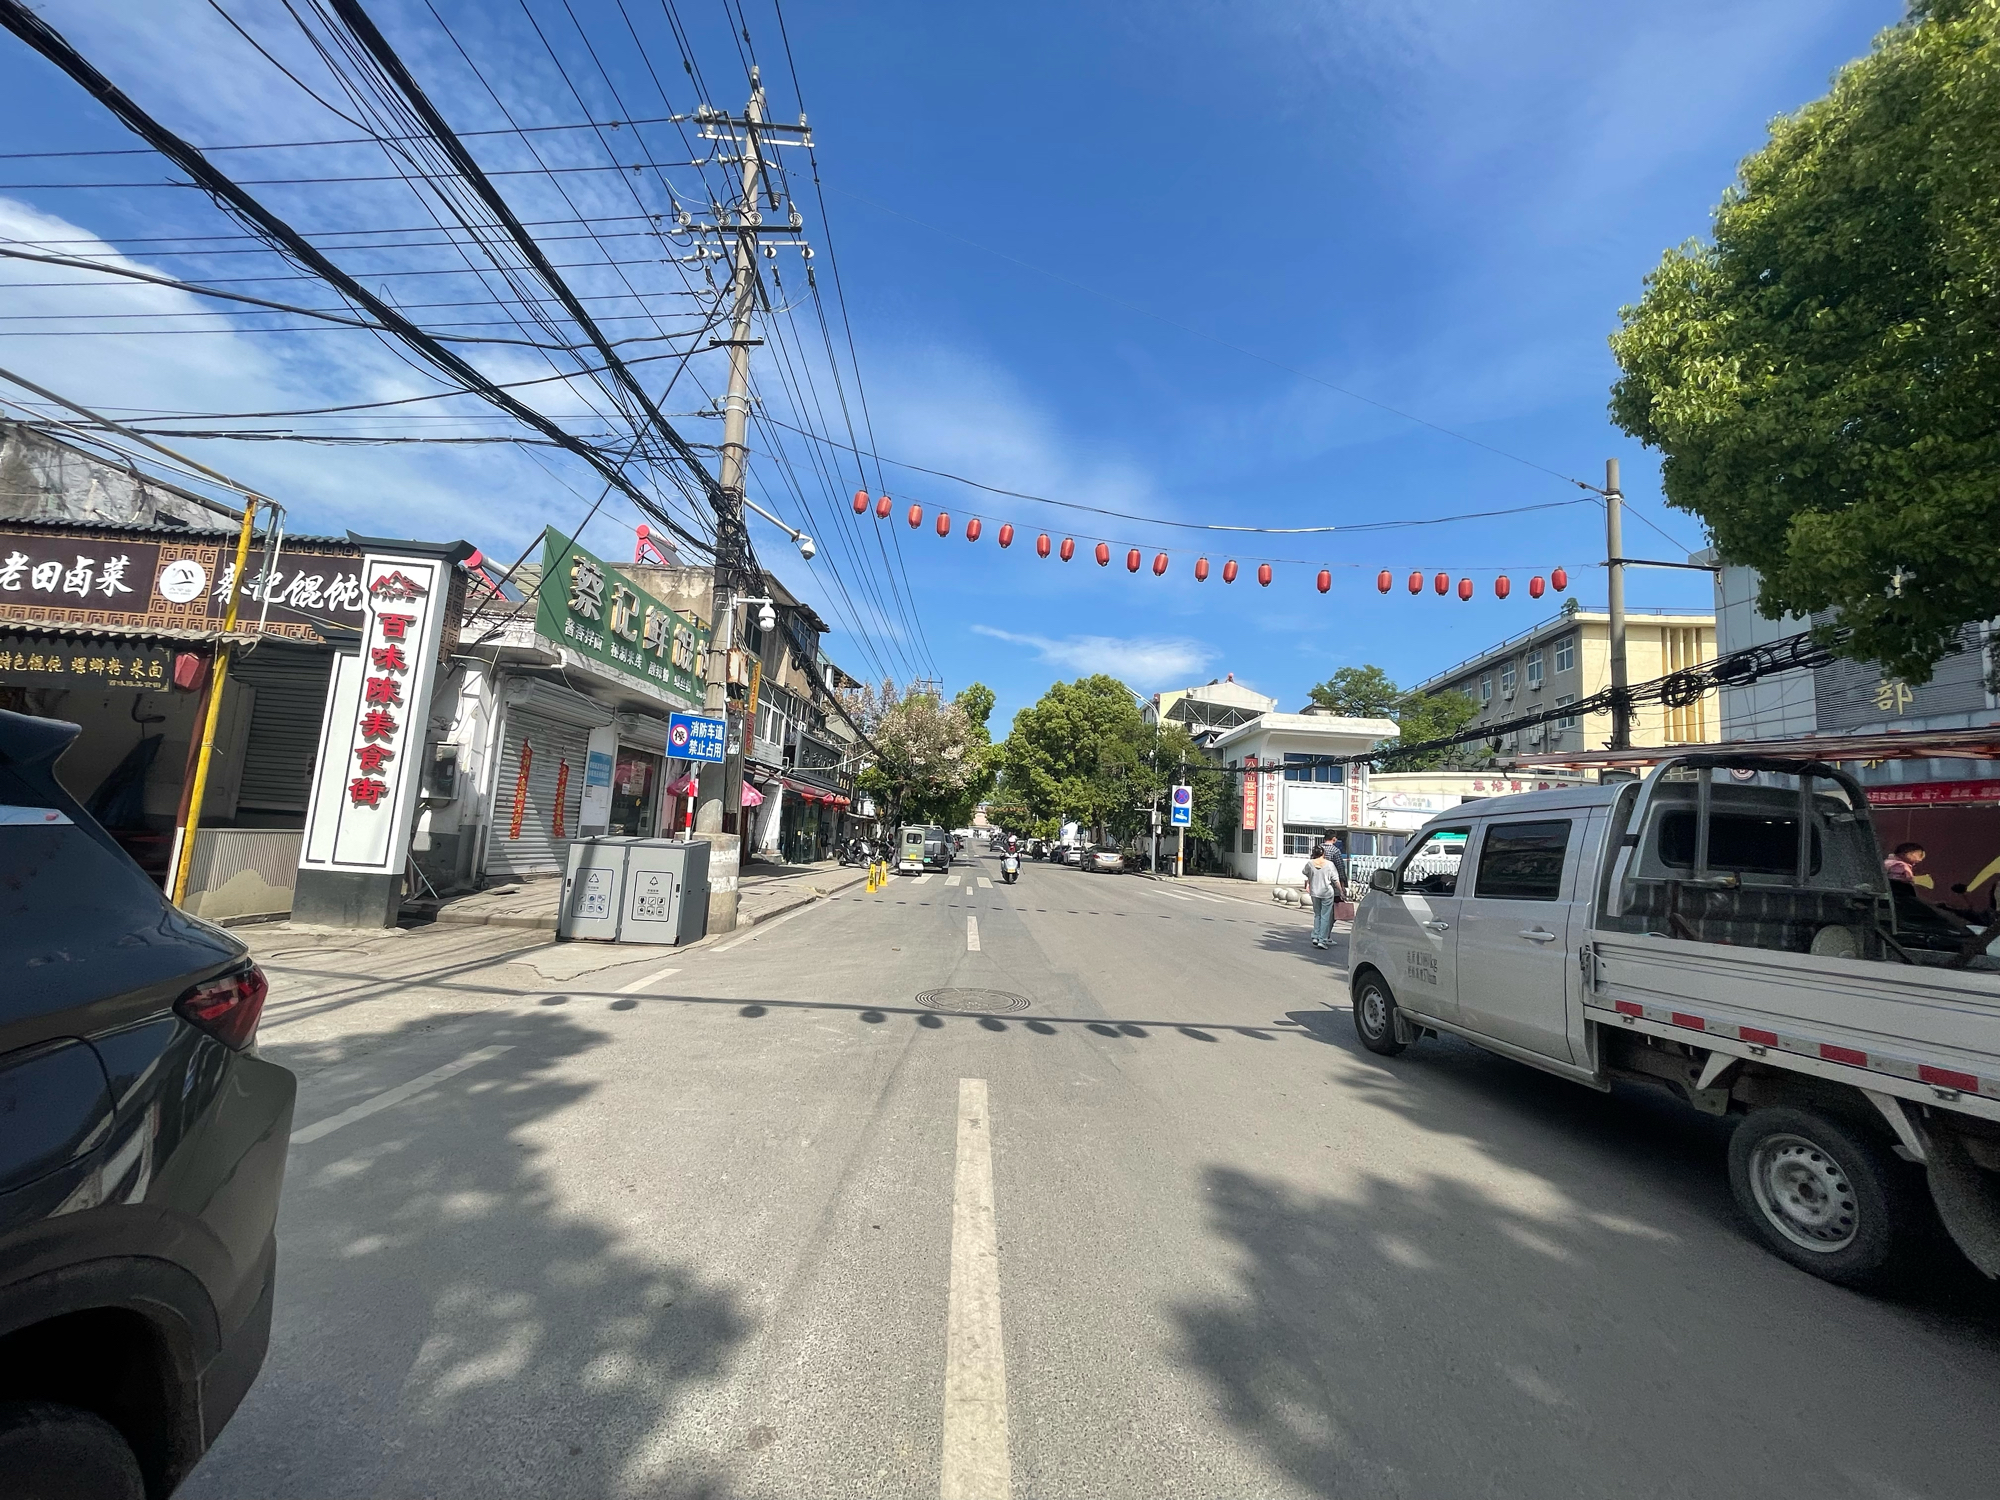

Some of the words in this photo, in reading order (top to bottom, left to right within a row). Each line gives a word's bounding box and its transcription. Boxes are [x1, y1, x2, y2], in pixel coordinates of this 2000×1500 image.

[0, 551, 135, 598] 老田卤菜
[212, 562, 363, 612] 蔡记馄饨
[349, 612, 416, 806] 百味陈美食街
[1870, 679, 1914, 715] 部
[688, 739, 722, 759] 禁止占用
[690, 720, 724, 740] 消防车道
